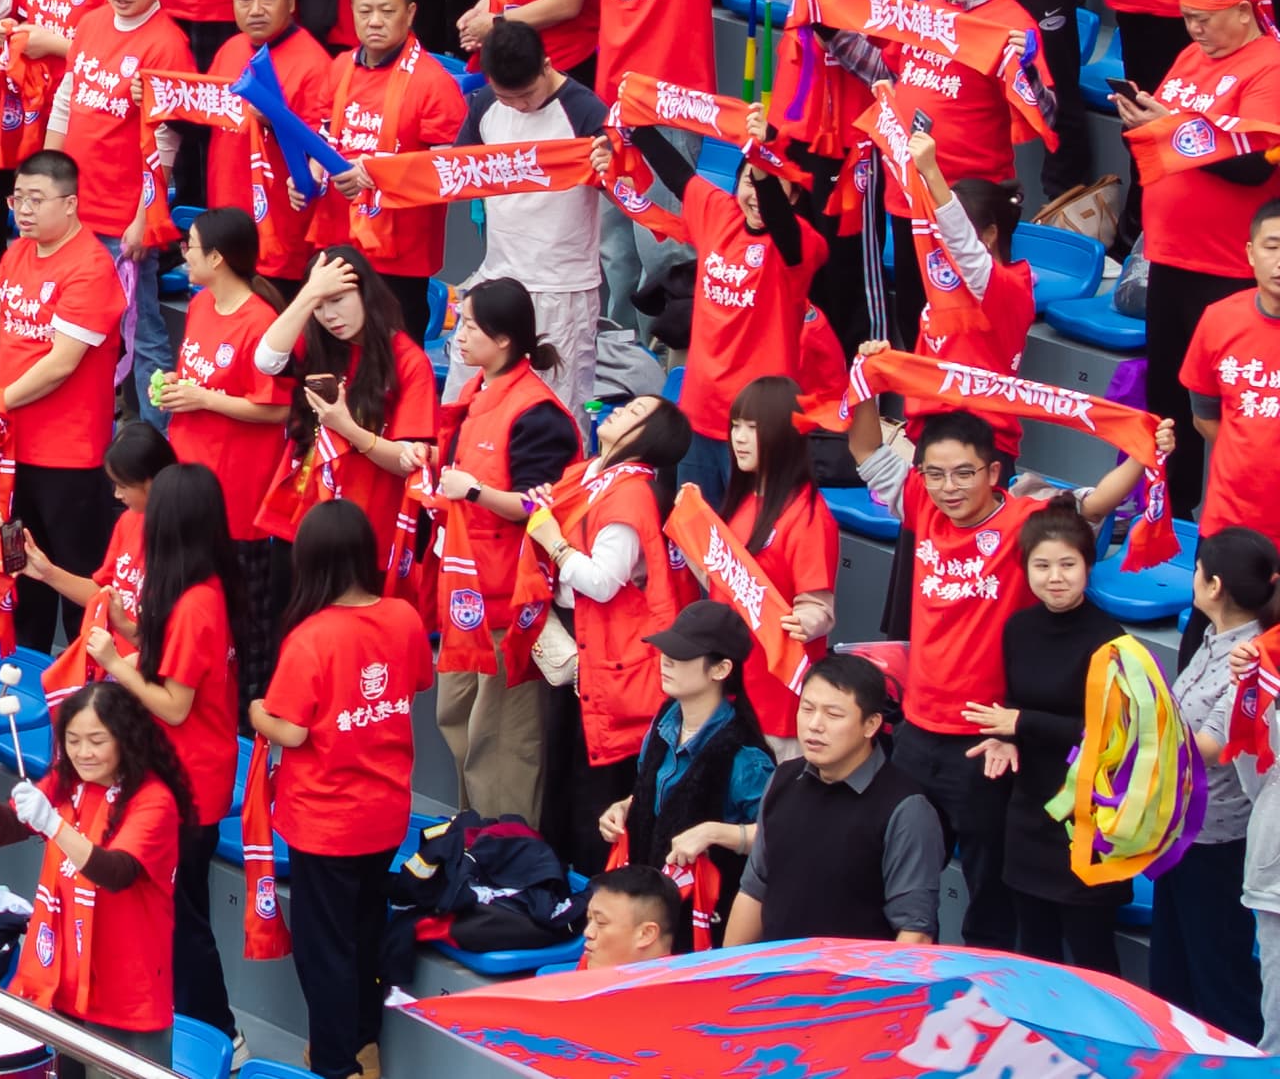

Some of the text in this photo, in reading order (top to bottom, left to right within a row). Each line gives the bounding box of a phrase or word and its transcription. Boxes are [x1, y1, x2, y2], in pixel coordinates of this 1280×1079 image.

[150, 77, 243, 124] 彭水雄起
[900, 67, 961, 99] 赛场纵横
[344, 108, 383, 135] 尤战神
[431, 148, 551, 197] 彭水雄起
[938, 363, 1097, 431] 为彭水而战
[705, 526, 767, 630] 彭水雄起
